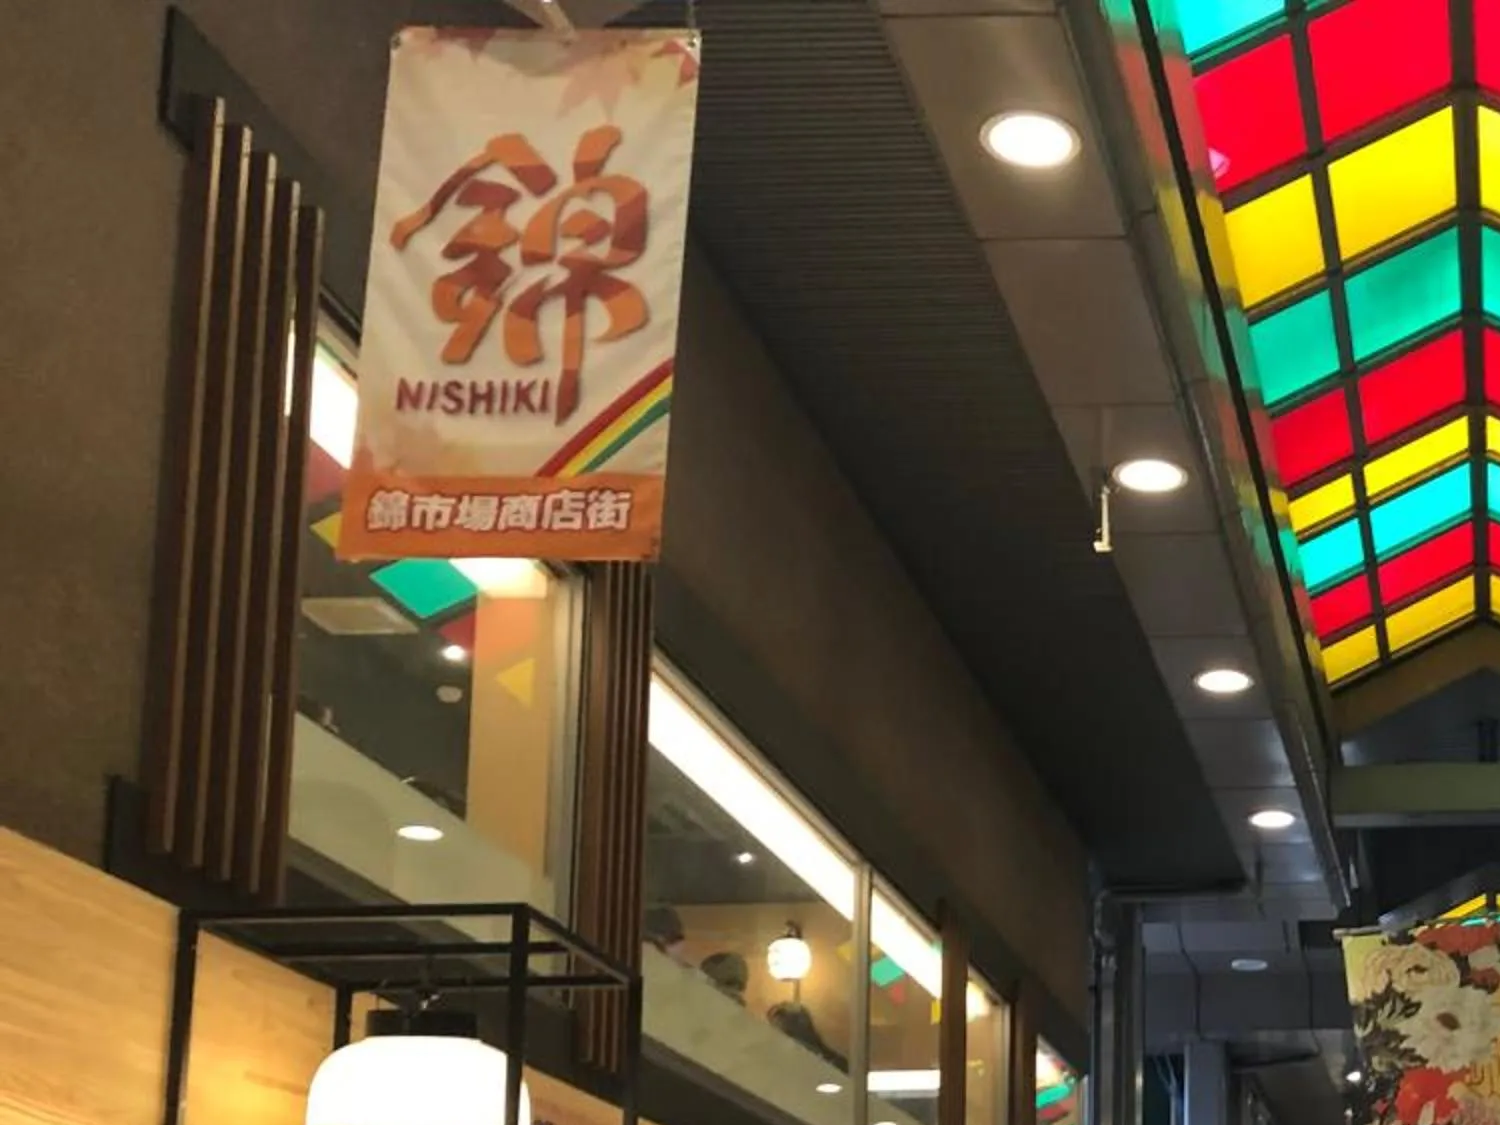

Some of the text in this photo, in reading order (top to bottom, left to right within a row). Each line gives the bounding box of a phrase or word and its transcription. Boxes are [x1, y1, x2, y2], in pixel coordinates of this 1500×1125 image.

[389, 124, 651, 428] 錦
[396, 376, 550, 416] NISHIKI
[367, 488, 632, 532] 錦市場商店街
